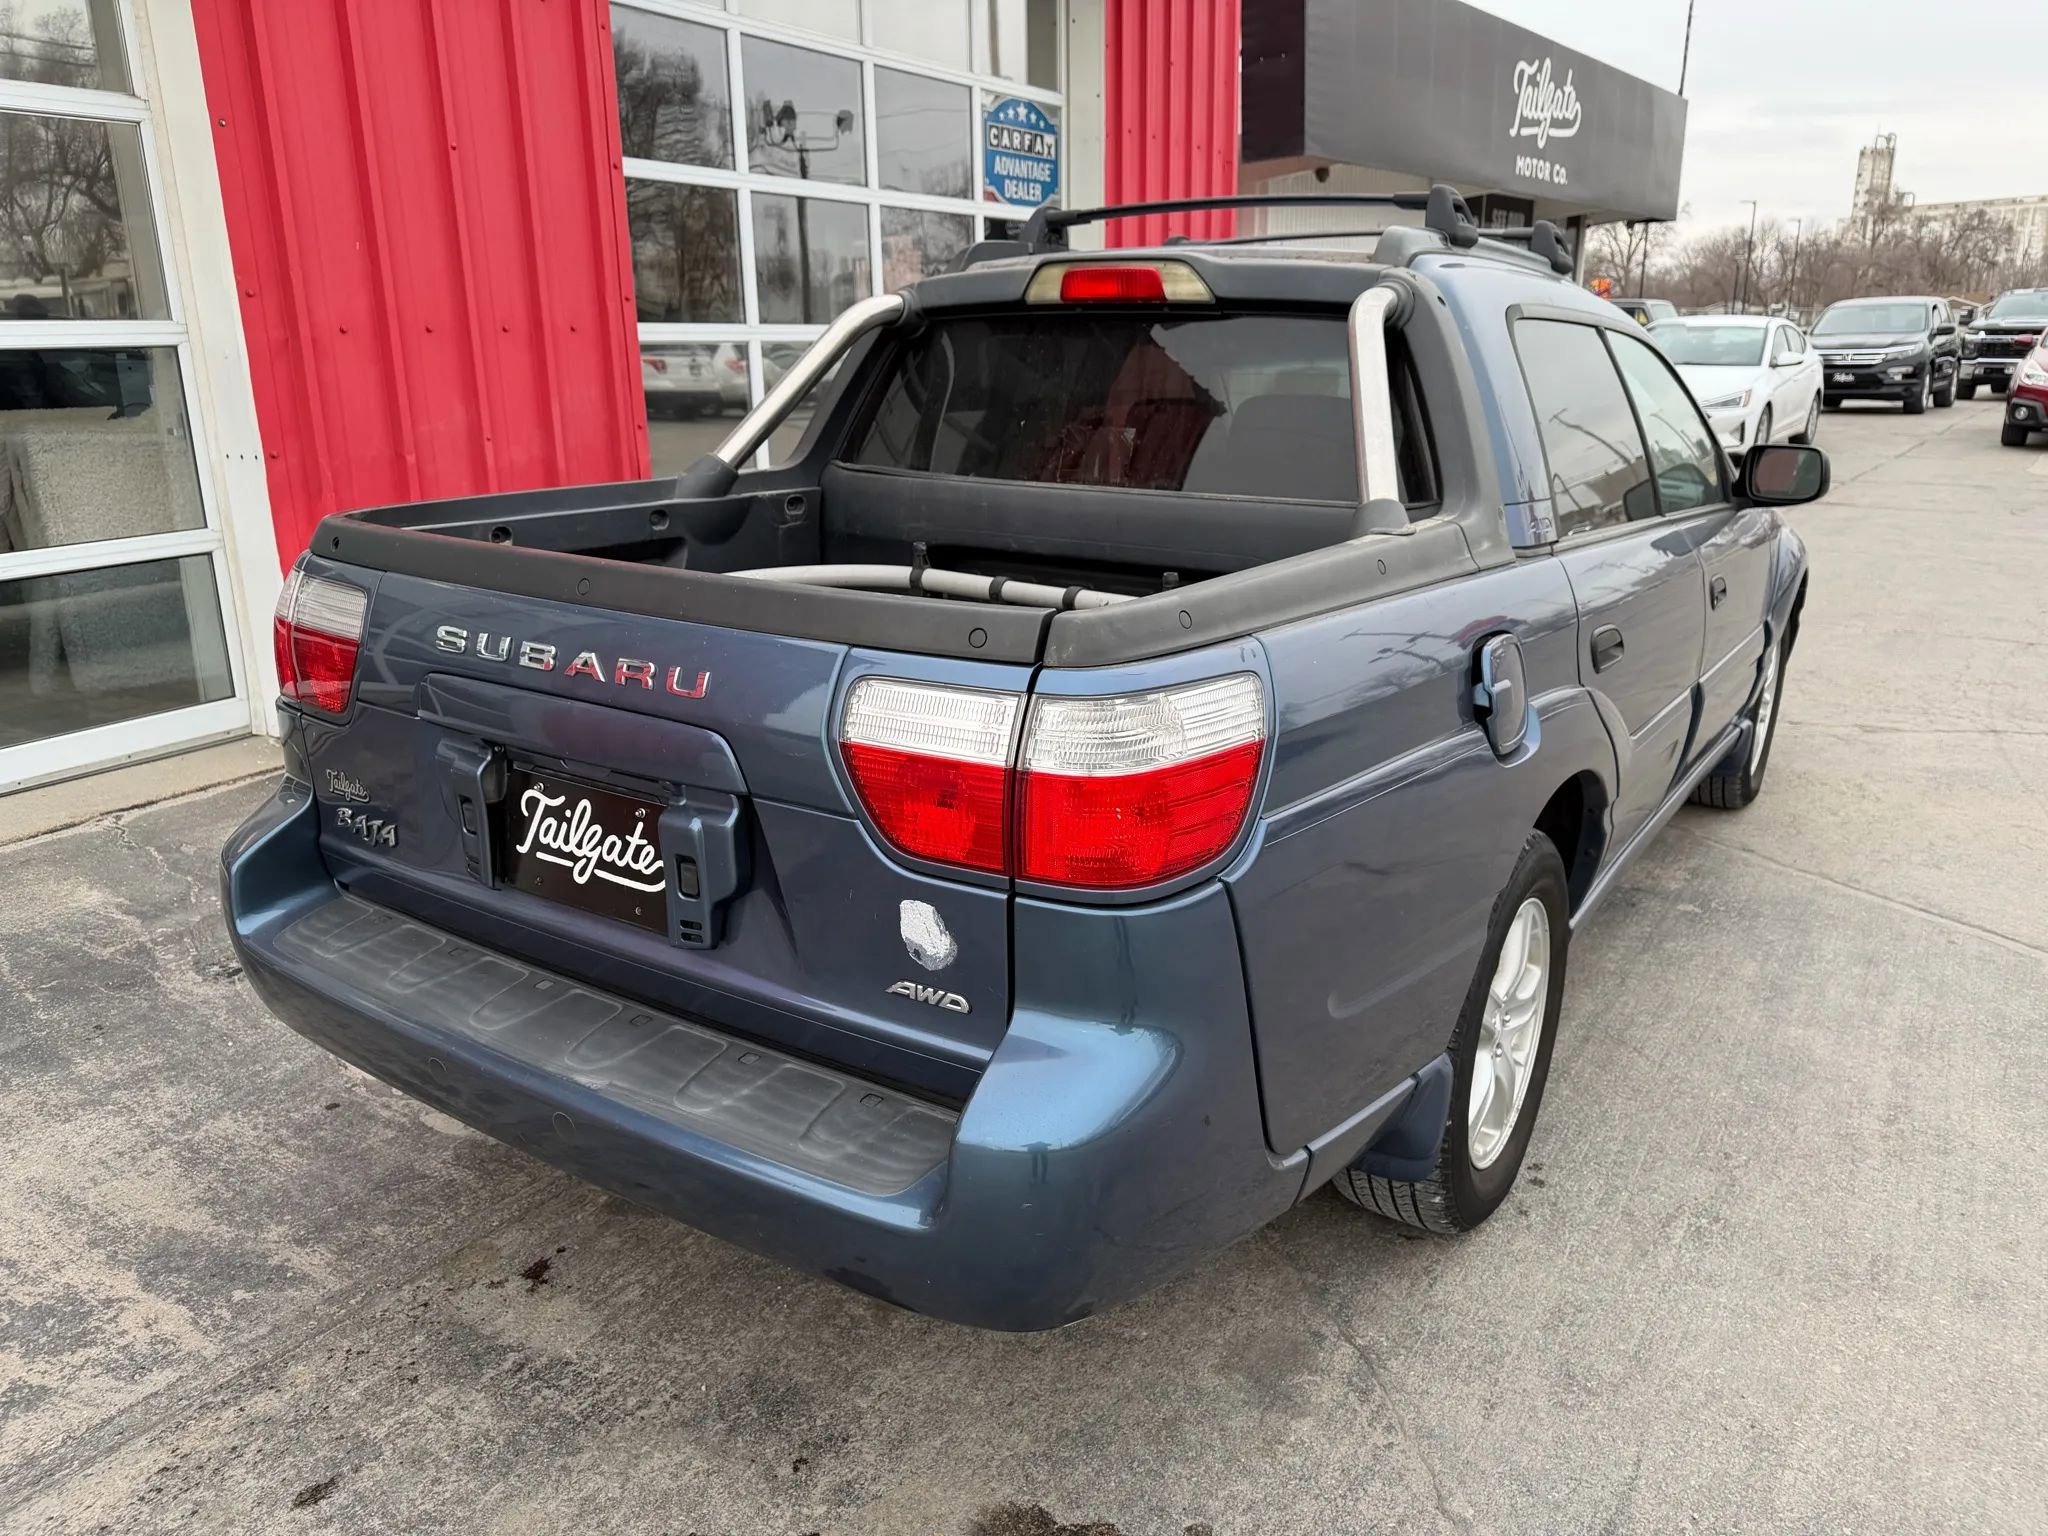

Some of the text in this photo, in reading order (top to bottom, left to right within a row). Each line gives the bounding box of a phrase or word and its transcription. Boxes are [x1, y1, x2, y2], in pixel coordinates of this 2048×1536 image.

[1509, 57, 1582, 149] Tailgate
[989, 125, 1054, 159] CARFAX
[994, 155, 1052, 182] ADVANTAGE
[1515, 155, 1568, 185] MOTOR CO.
[1004, 179, 1042, 202] DEALER
[435, 624, 712, 699] SUBARU
[326, 768, 370, 803] Tailgate
[516, 789, 666, 893] Tailgate
[885, 981, 970, 1014] AWD
